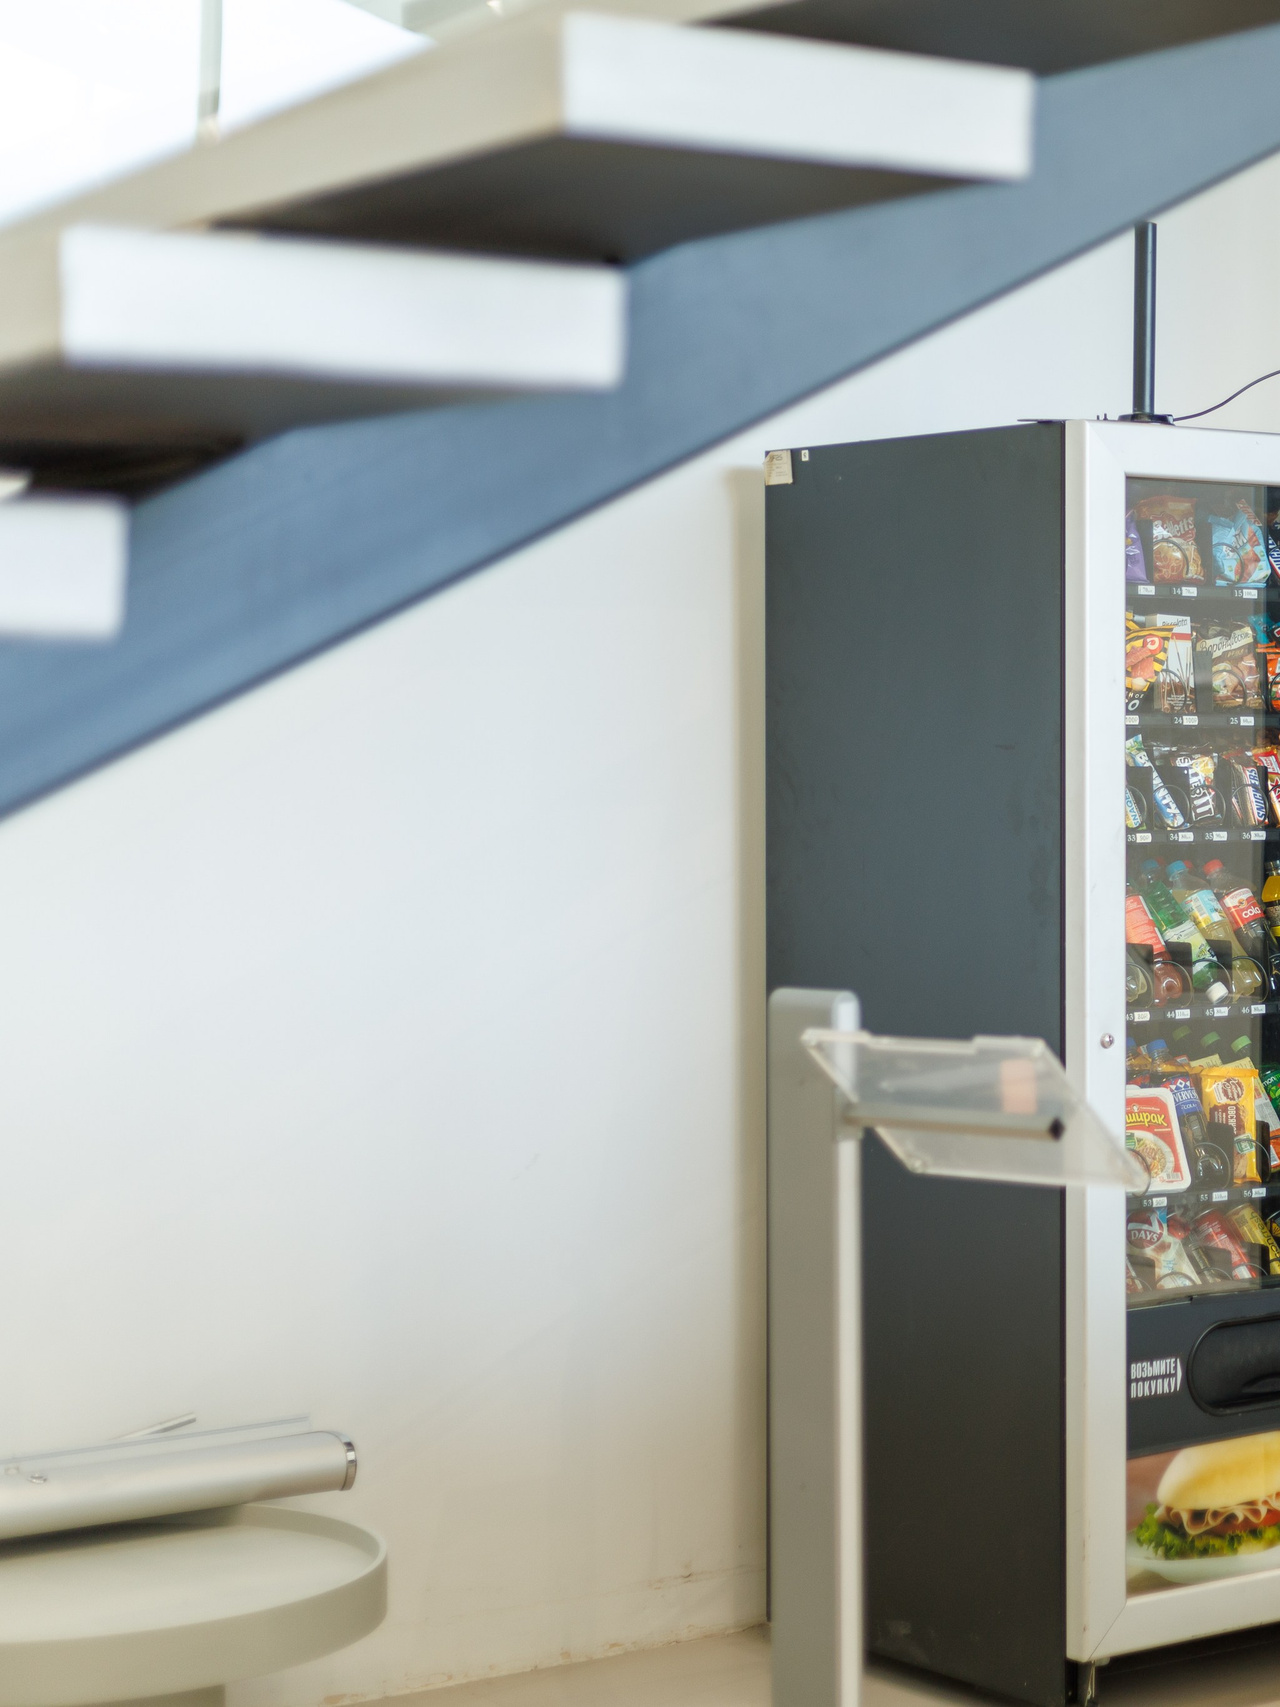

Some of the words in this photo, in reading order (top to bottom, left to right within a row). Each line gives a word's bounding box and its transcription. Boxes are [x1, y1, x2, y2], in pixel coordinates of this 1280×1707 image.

[1242, 832, 1250, 840] 36
[1241, 906, 1261, 919] cola
[1242, 1006, 1250, 1014] 46
[1130, 1230, 1160, 1243] DAYS
[1131, 1358, 1176, 1380] ВОЗЬМИТЕ
[1131, 1377, 1176, 1398] ПОКУПКУ
